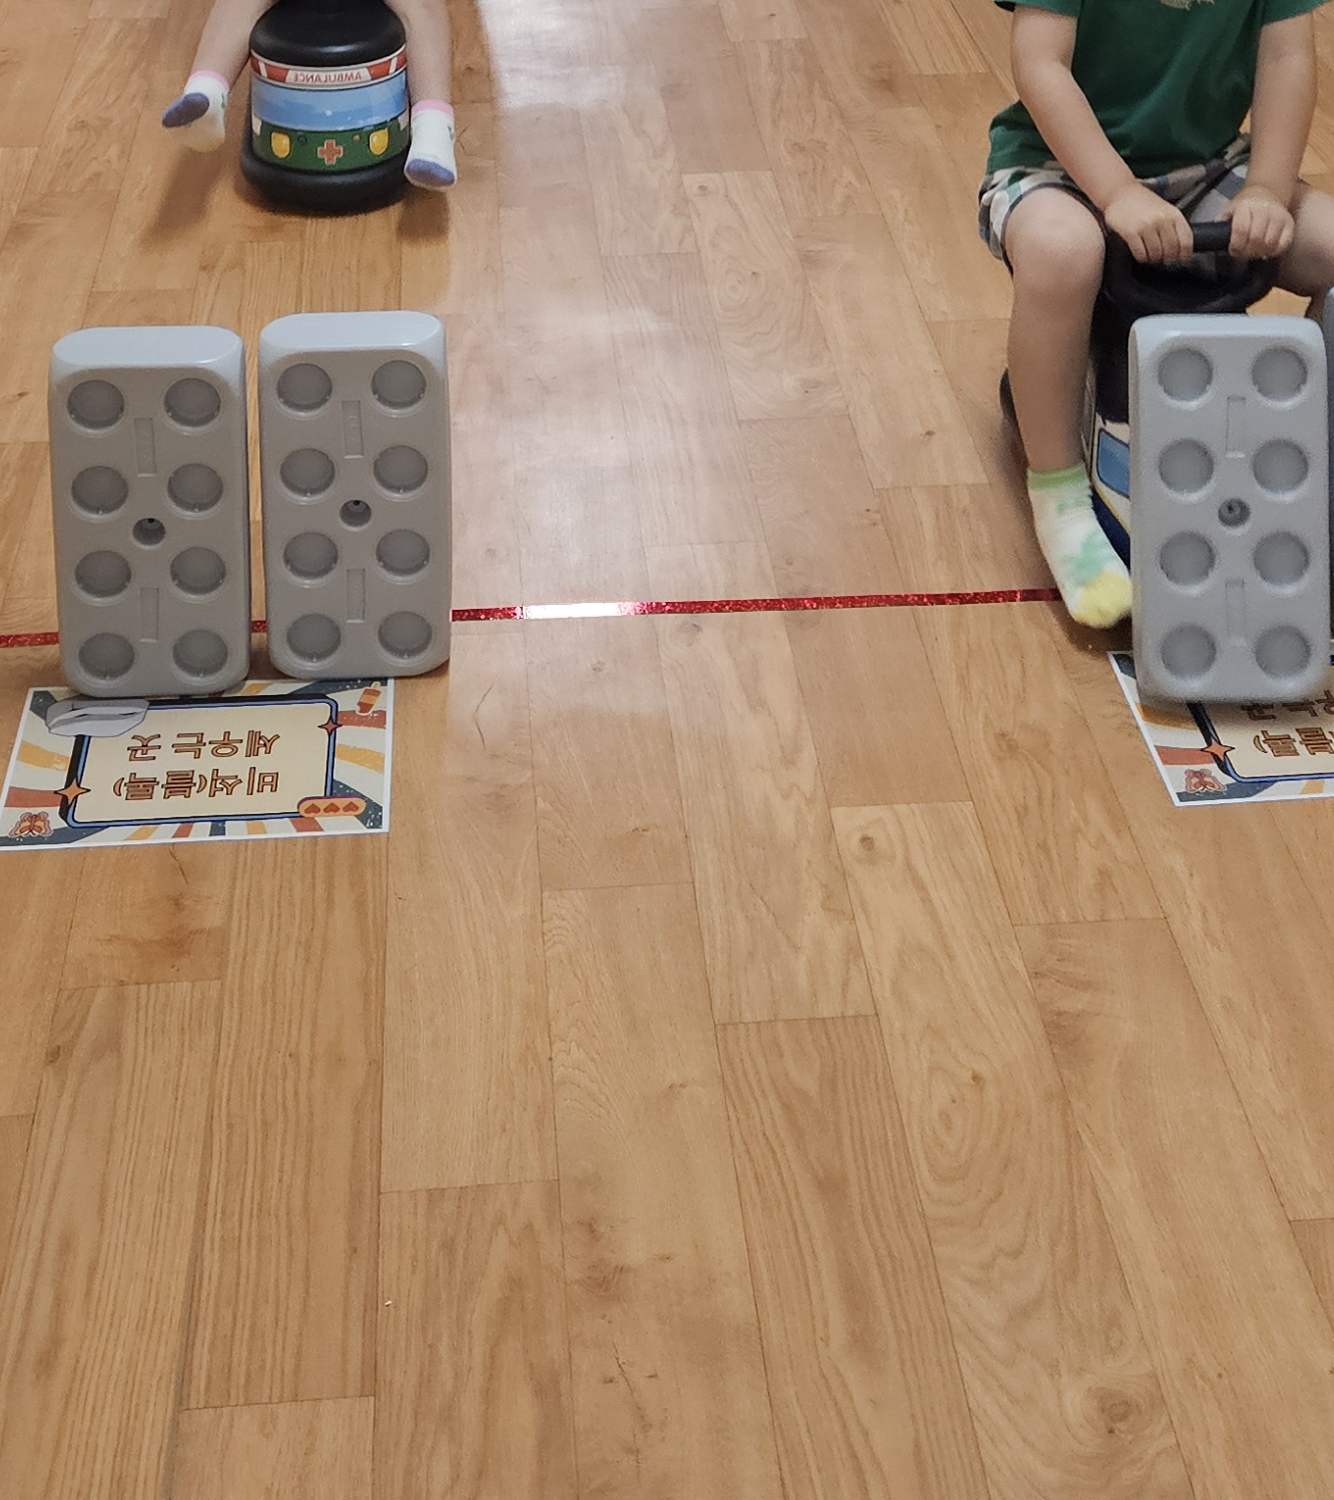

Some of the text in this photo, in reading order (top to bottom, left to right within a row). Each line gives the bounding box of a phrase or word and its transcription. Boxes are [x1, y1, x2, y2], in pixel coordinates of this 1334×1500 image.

[127, 729, 280, 762] 세우는 곳
[113, 766, 279, 801] 비석(블록)
